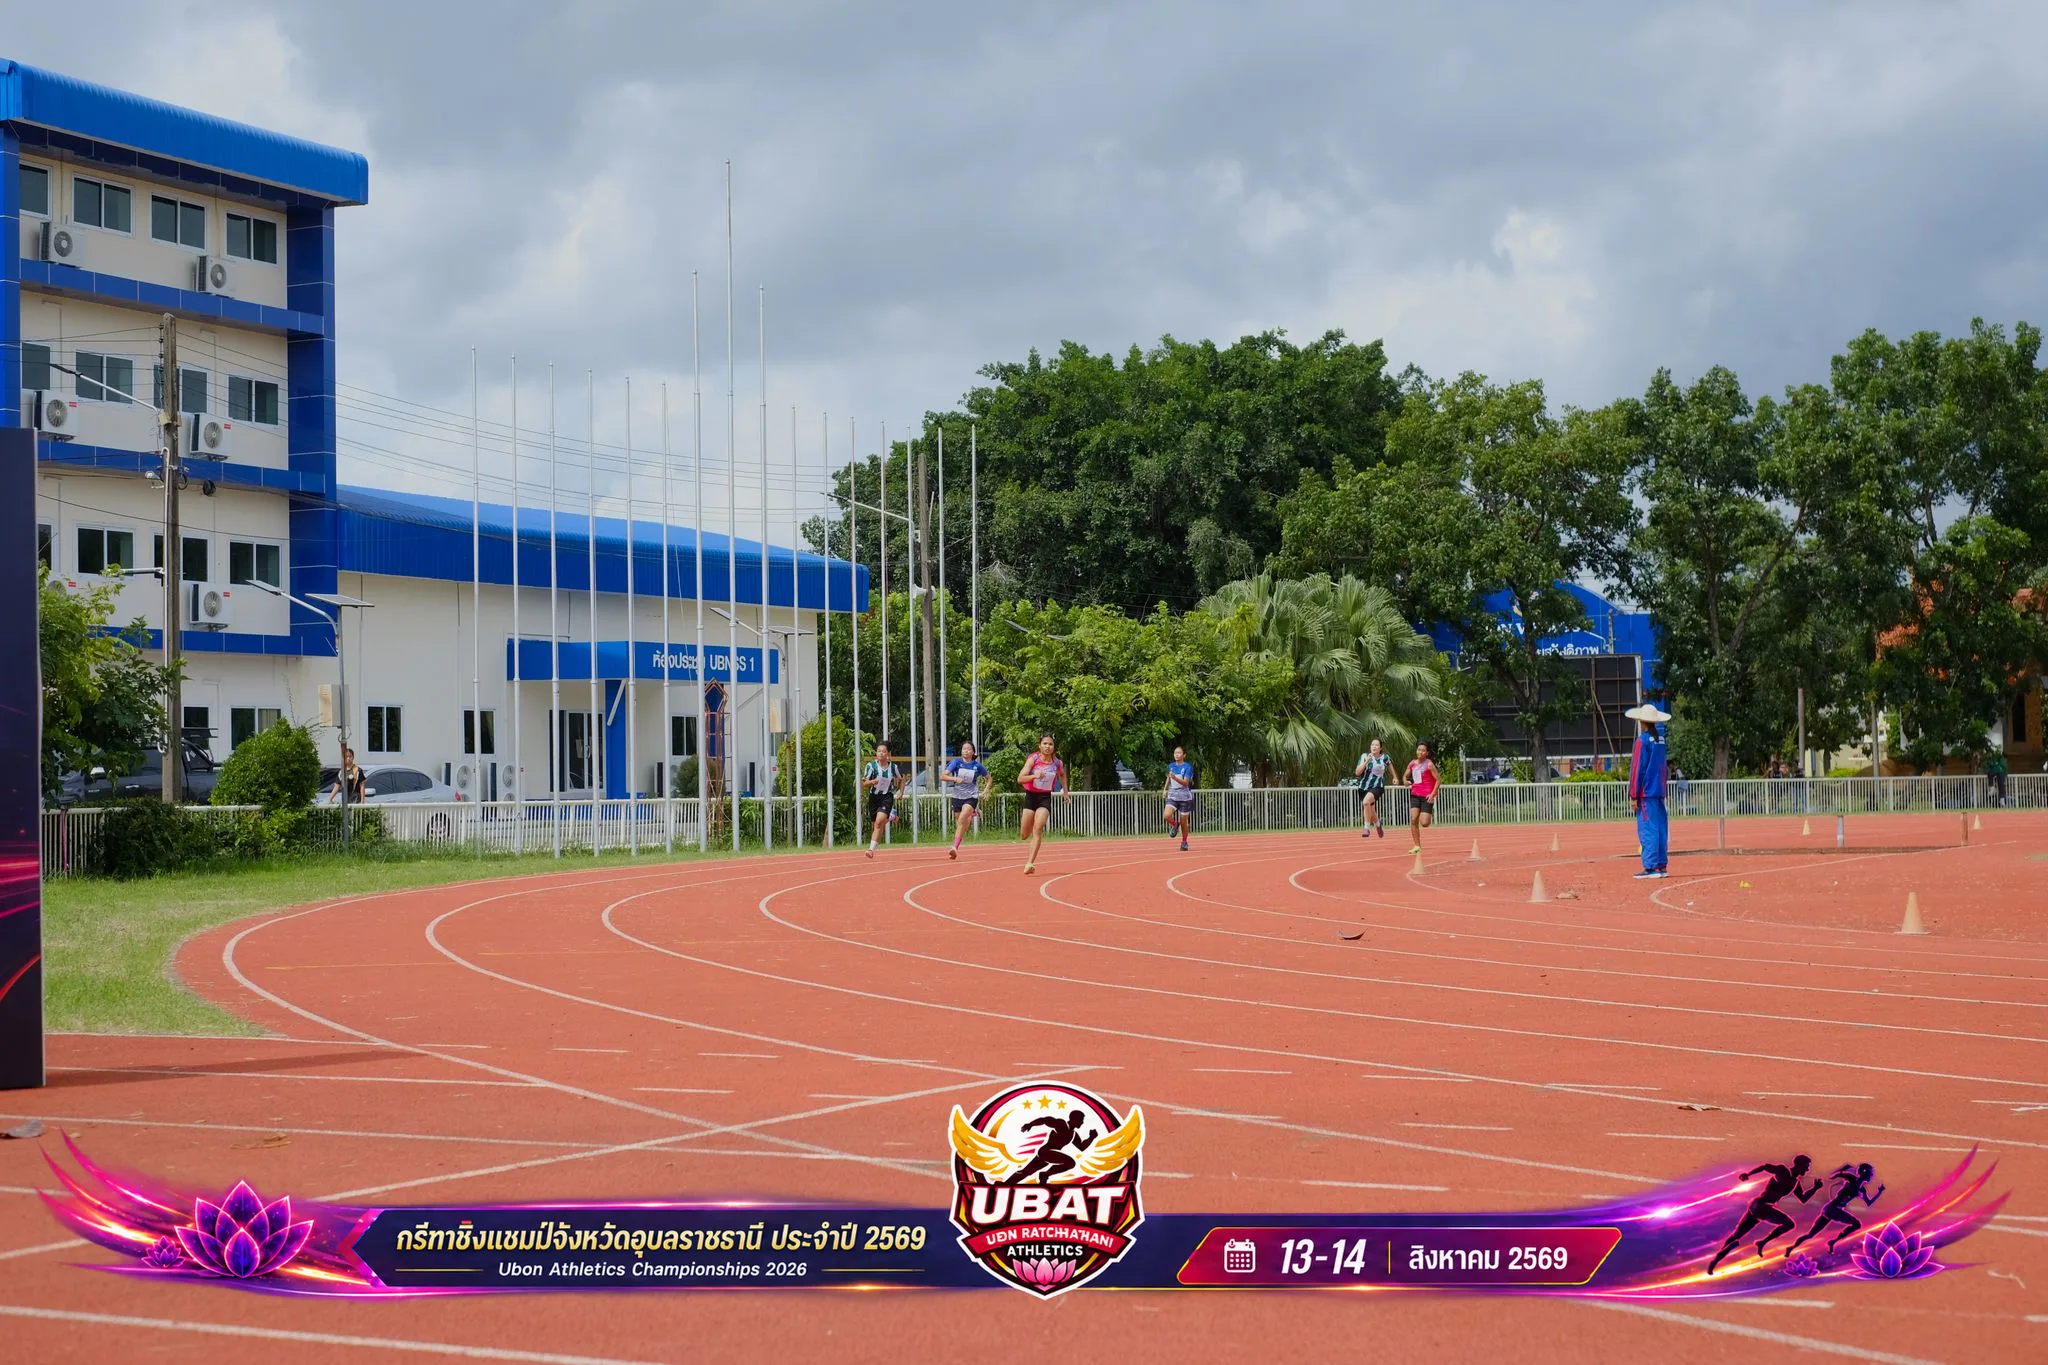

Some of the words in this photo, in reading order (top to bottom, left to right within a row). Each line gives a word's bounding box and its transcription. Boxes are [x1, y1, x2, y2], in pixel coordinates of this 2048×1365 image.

[652, 649, 706, 675] ห้องประชุ
[749, 656, 755, 672] 1
